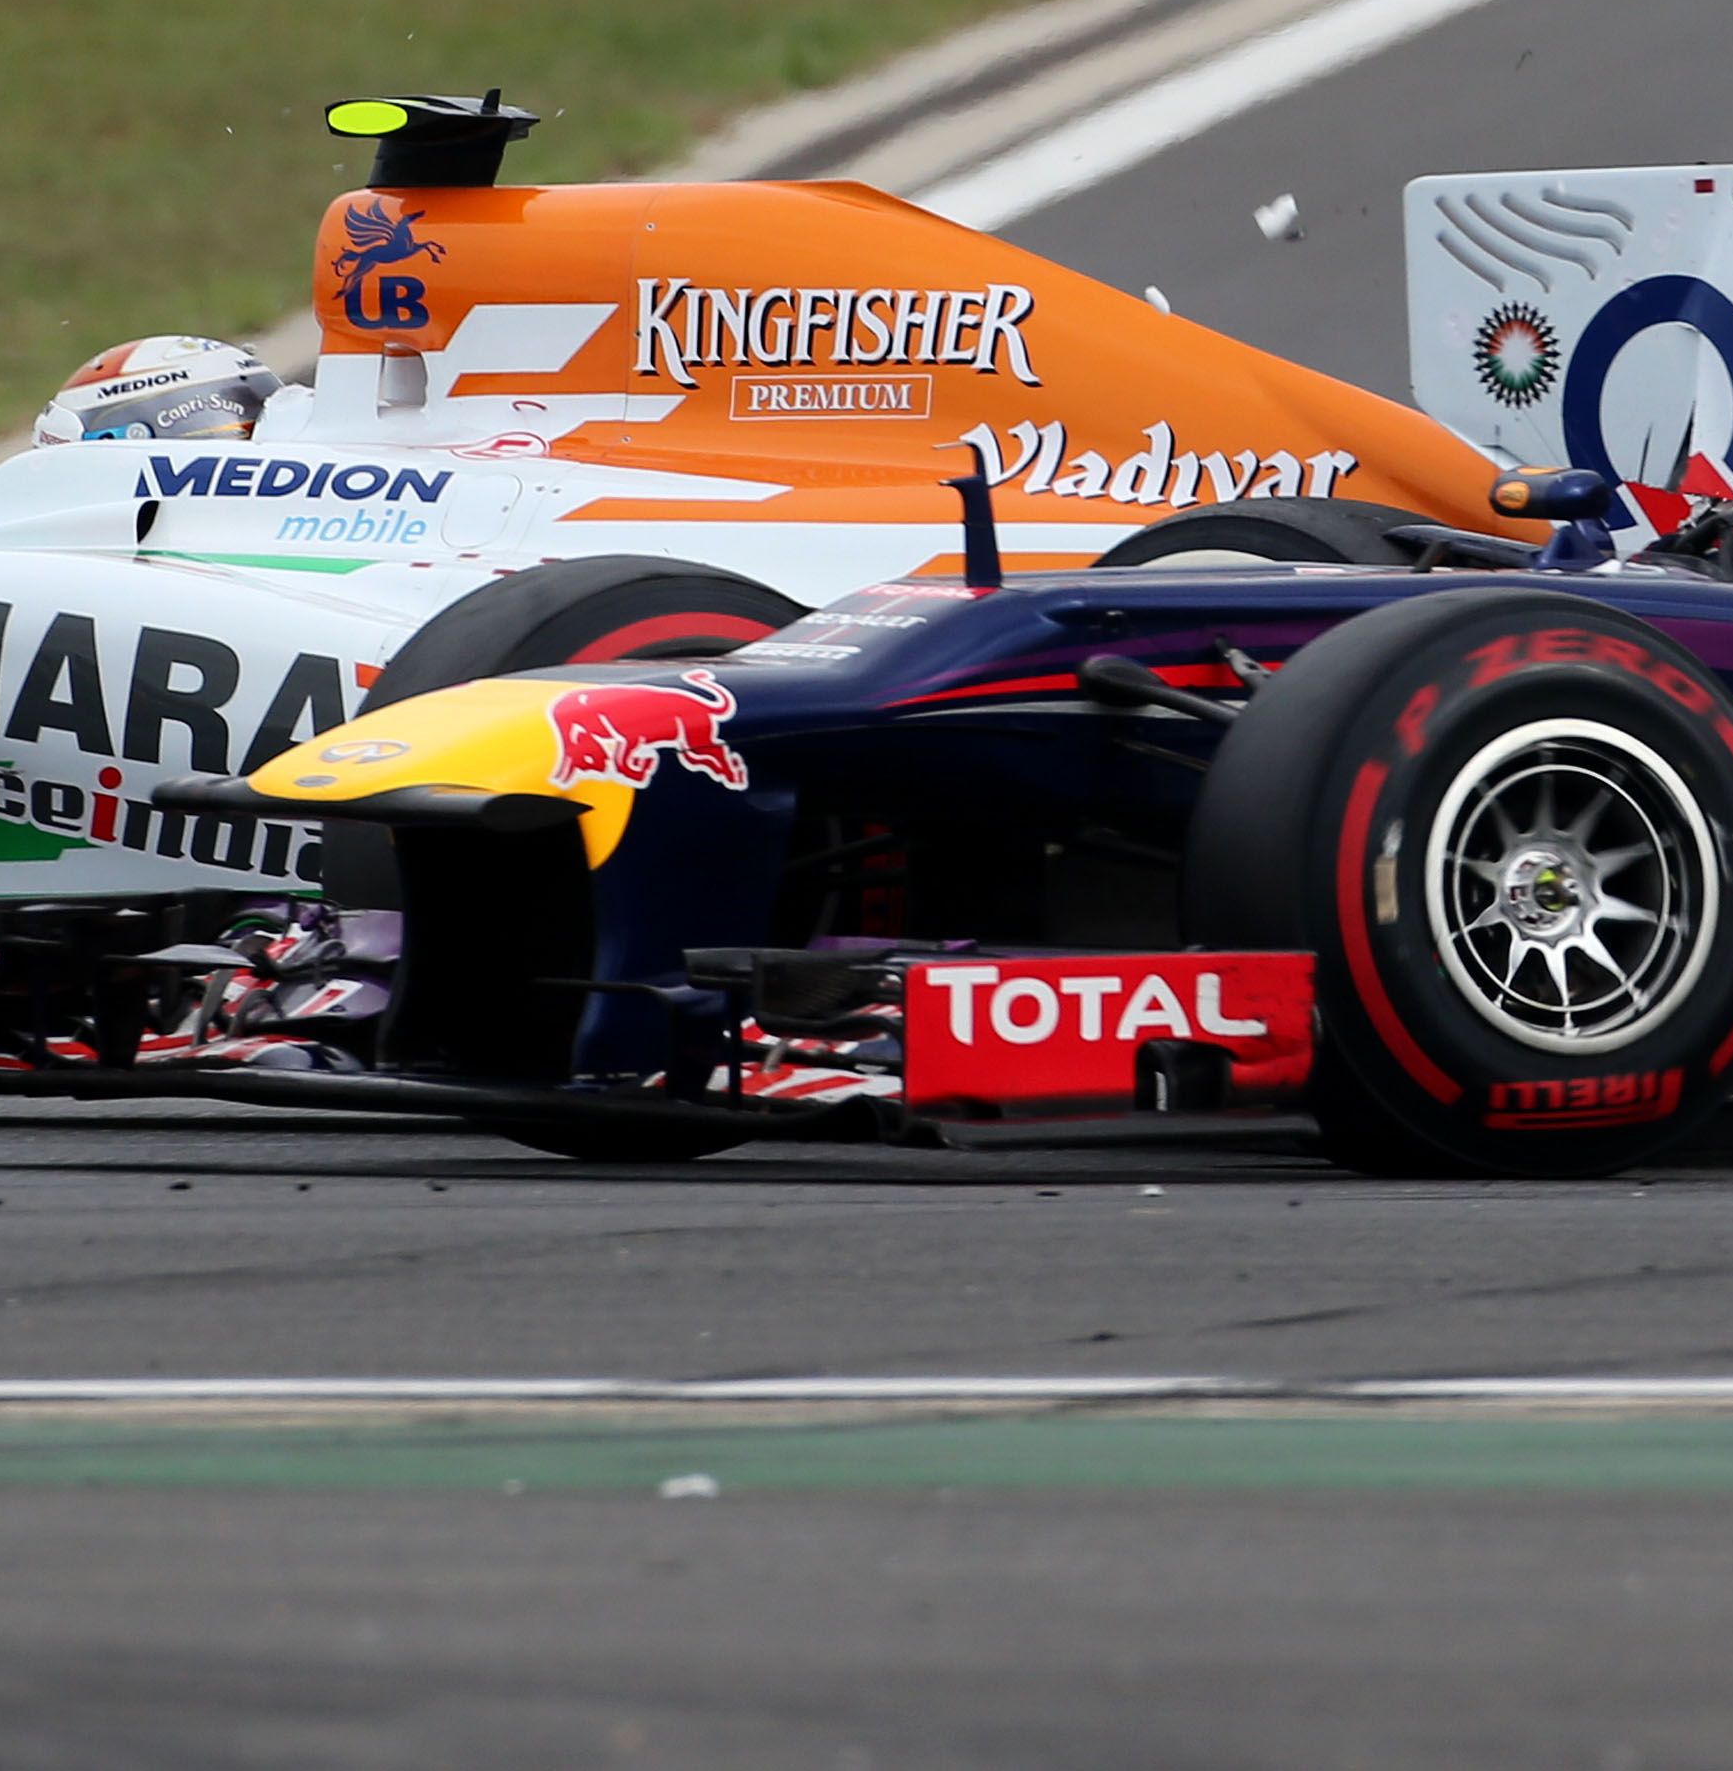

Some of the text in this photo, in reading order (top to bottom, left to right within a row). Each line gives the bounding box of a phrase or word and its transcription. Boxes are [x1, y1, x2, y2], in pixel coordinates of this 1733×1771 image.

[635, 277, 1044, 389] KINGFISHER
[97, 370, 190, 400] MEDION
[747, 383, 914, 412] PREMIUM
[135, 456, 455, 504] MEDION
[964, 418, 1361, 511] Vladivar
[275, 509, 428, 545] mobile
[1392, 629, 1714, 757] P ZERO
[927, 968, 1267, 1045] TOTAL
[1482, 1068, 1685, 1128] PIRELLI
